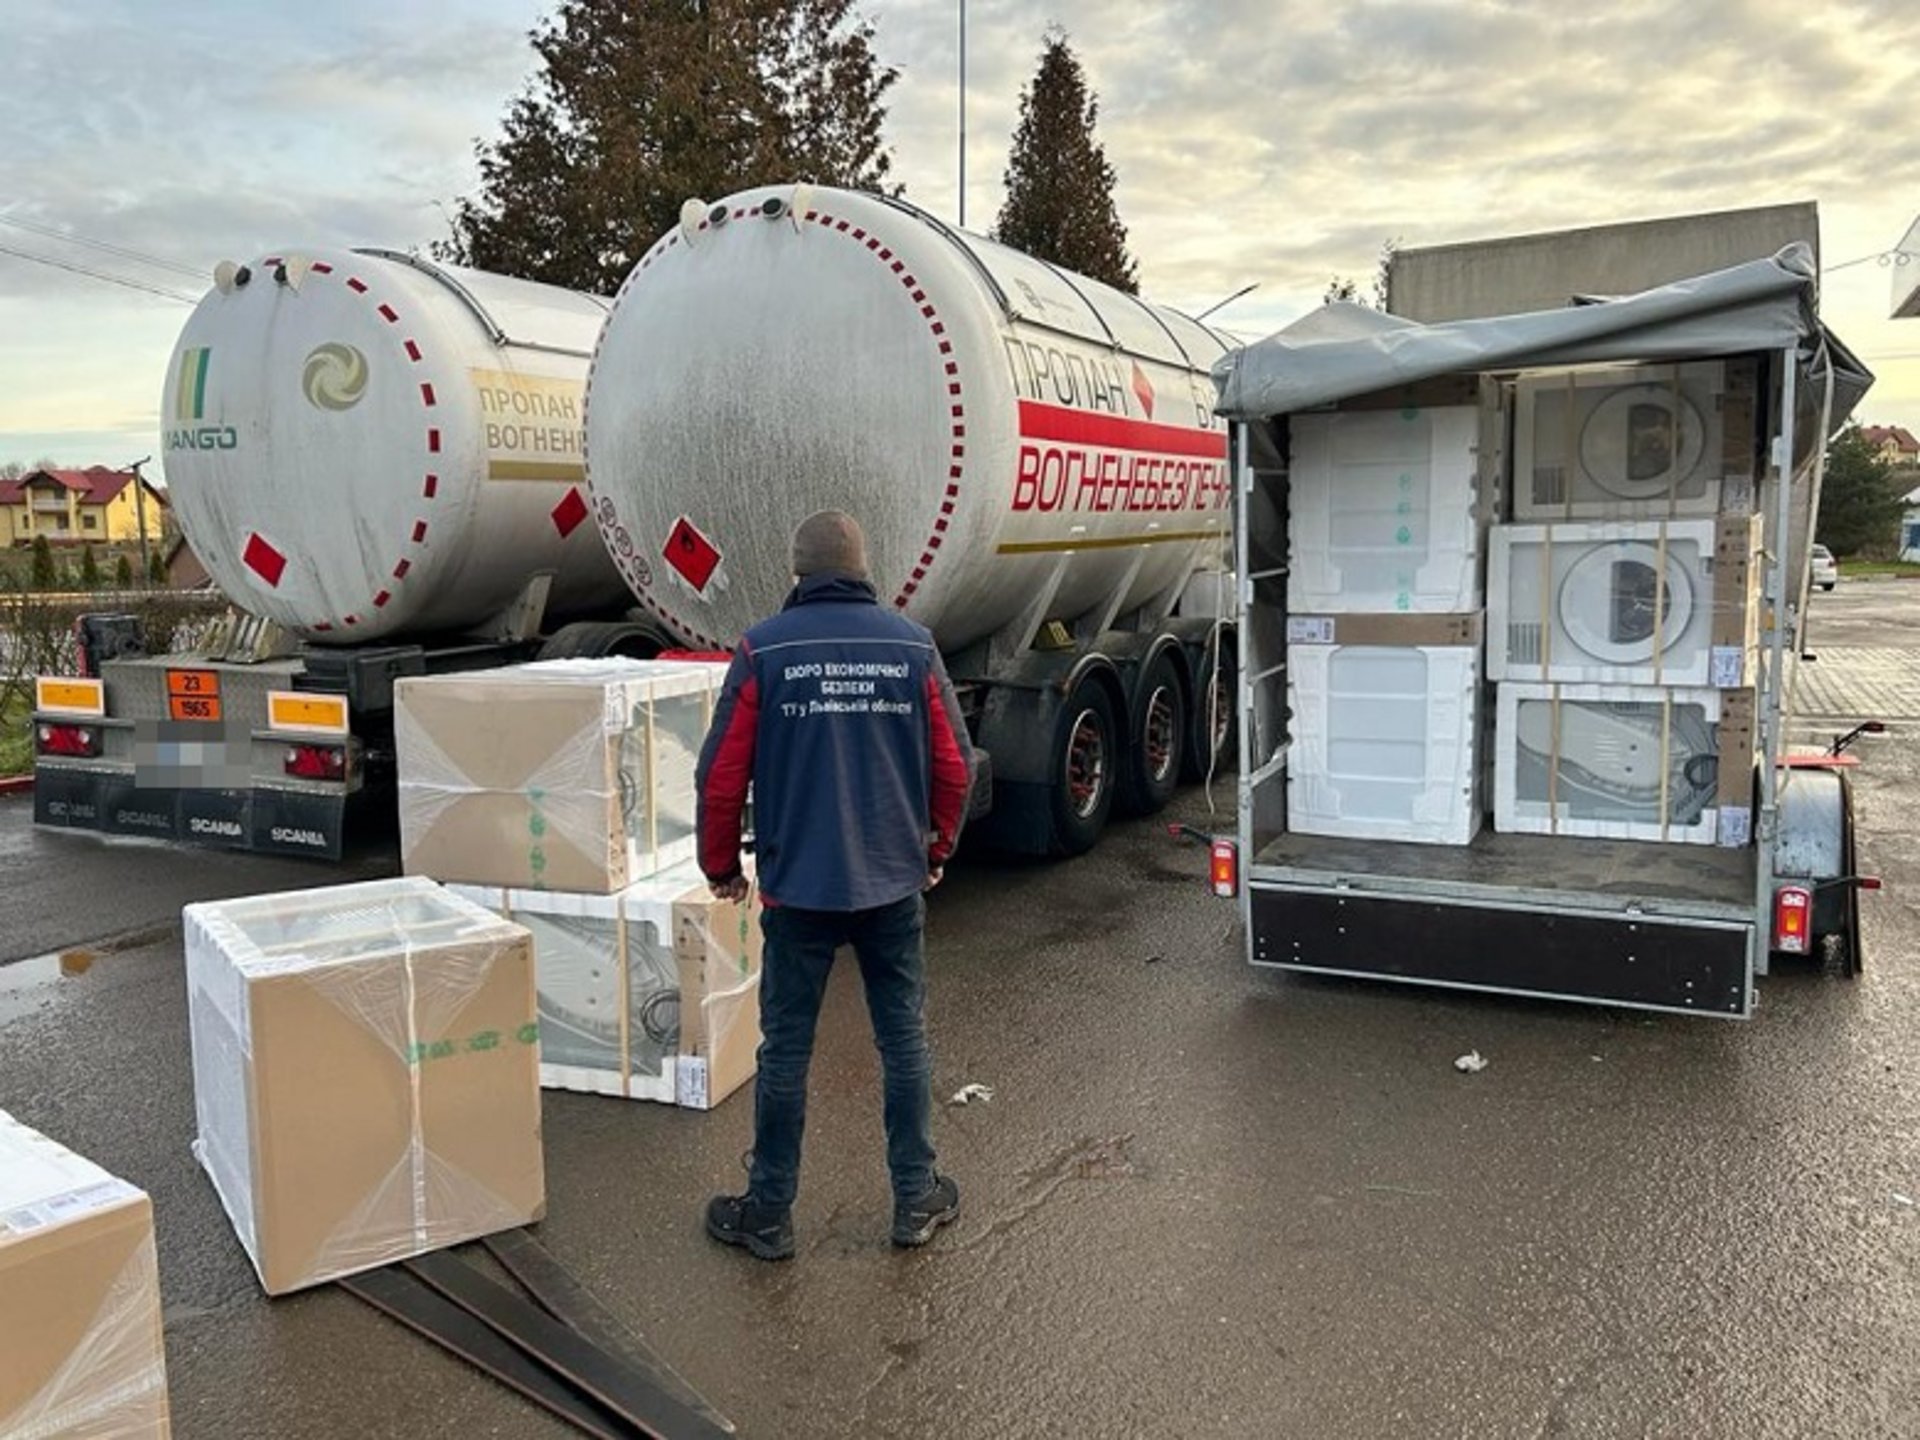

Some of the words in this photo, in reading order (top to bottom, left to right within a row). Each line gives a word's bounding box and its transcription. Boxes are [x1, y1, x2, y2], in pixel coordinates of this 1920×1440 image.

[1003, 335, 1129, 417] ПРОПАН
[479, 387, 577, 419] ПРОПАН
[164, 427, 238, 450] ANGO
[784, 663, 822, 680] БЮРО
[824, 661, 909, 679] ЕКОНОМІЧНОЇ
[184, 675, 201, 691] 23
[820, 681, 875, 695] БЕЗПЕКИ
[181, 701, 211, 717] 1965
[190, 817, 243, 836] SCANIA
[270, 826, 327, 847] SCANIA
